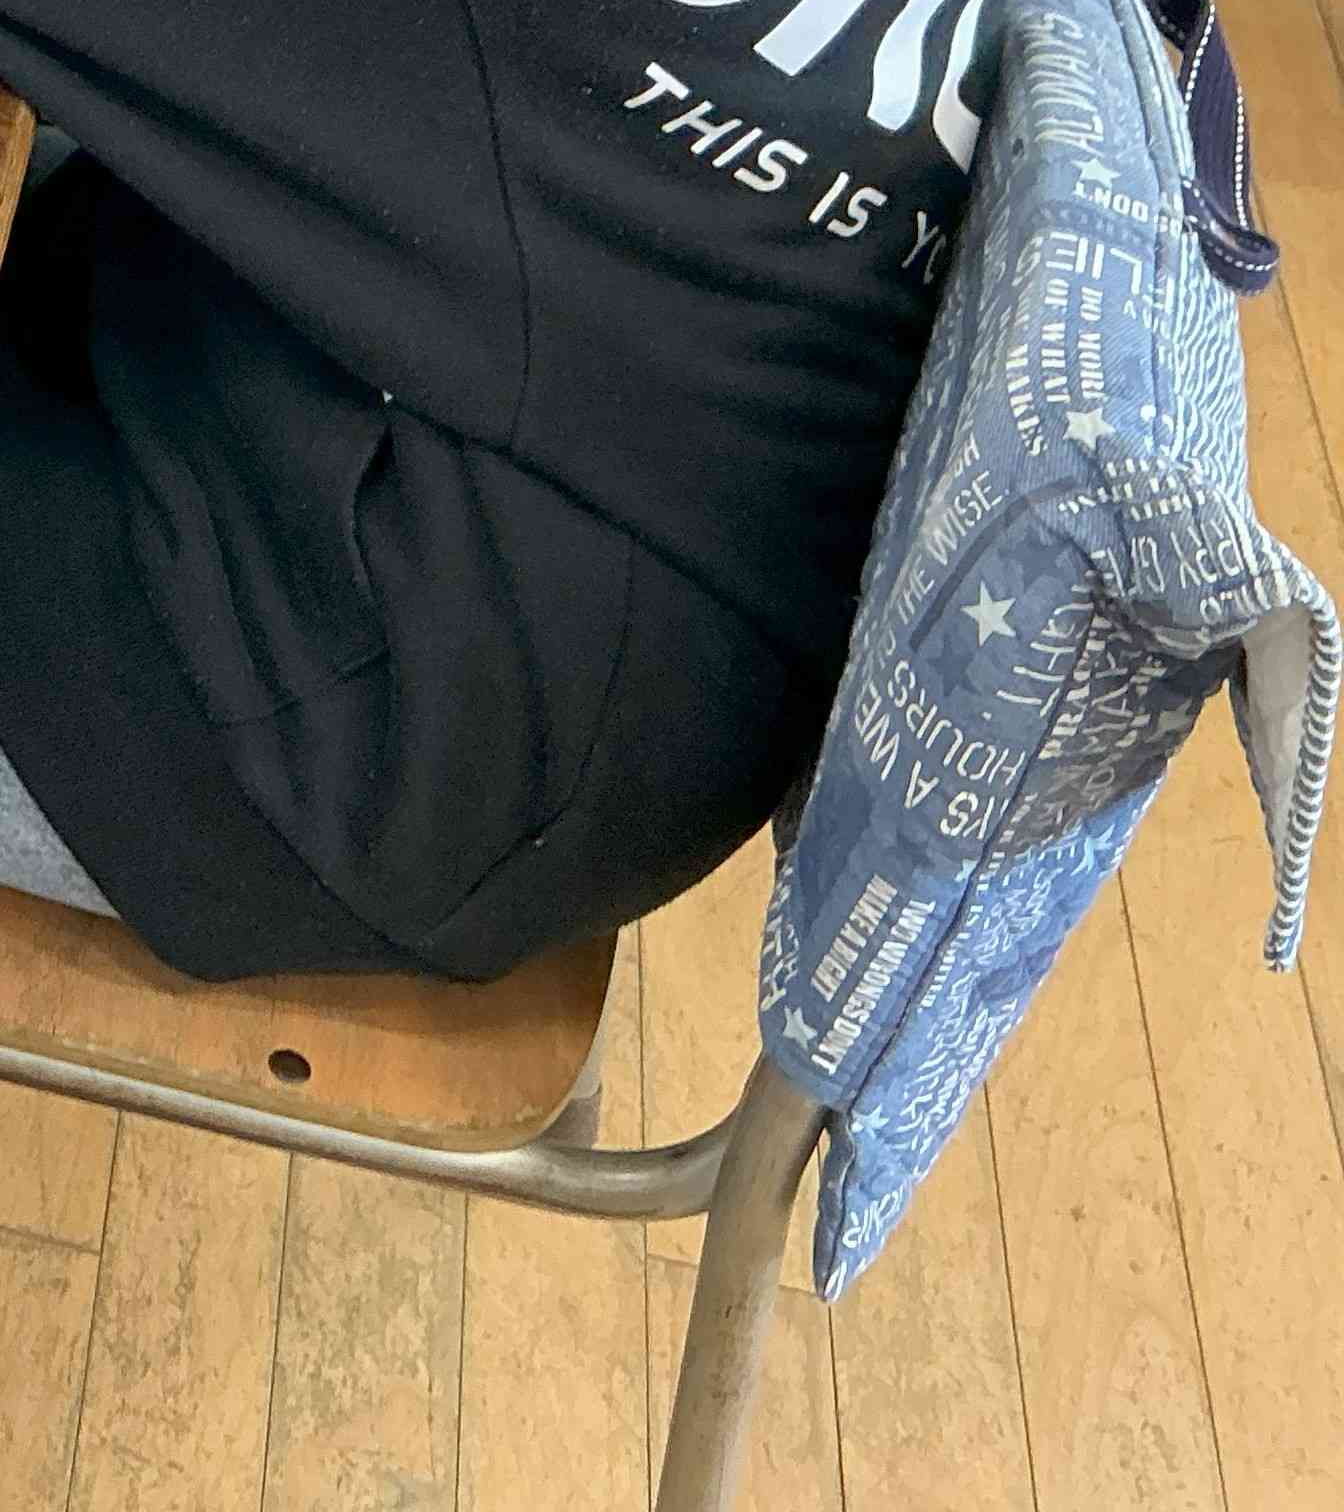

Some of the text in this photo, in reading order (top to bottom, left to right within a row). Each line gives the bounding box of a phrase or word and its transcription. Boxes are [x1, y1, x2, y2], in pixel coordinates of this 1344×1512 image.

[623, 62, 808, 192] THIS
[809, 172, 888, 238] IS
[888, 660, 1026, 786] HOURS
